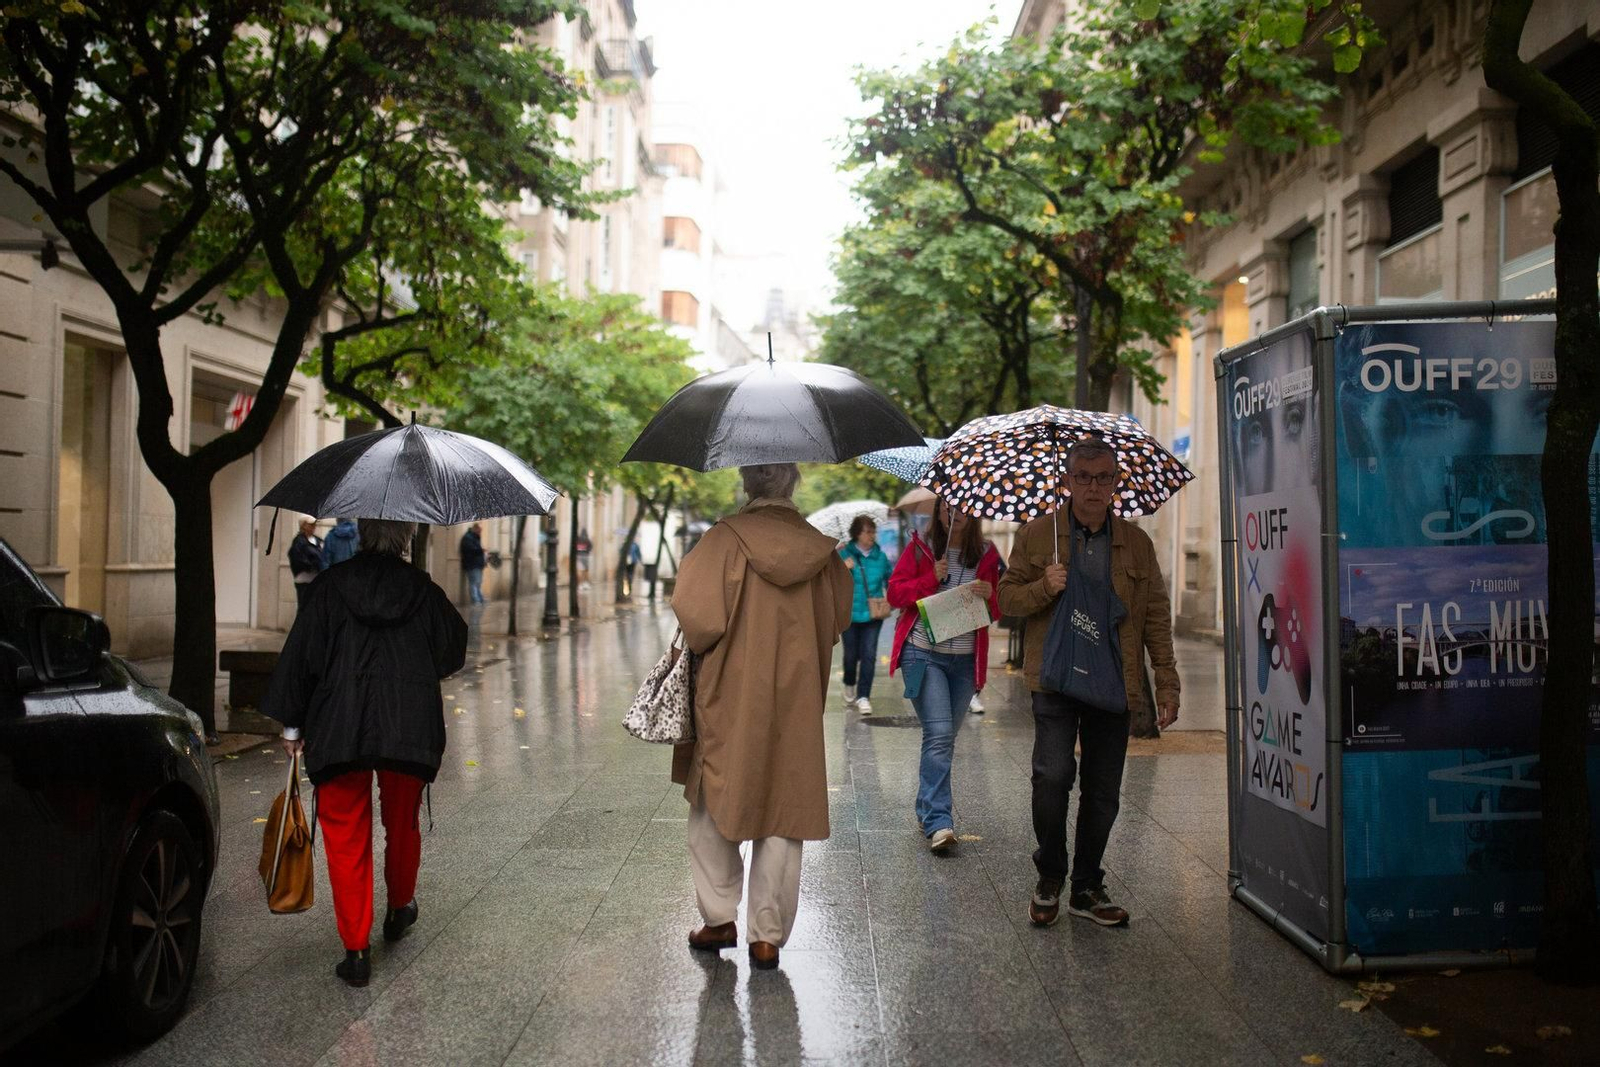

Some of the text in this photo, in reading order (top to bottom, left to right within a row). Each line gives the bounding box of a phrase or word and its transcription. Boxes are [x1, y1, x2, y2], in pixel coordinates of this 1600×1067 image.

[1360, 355, 1523, 393] OUFF29
[1233, 377, 1281, 420] OUFF29
[1245, 507, 1288, 551] OUFF
[1483, 577, 1520, 592] EDICIÓN
[1396, 601, 1463, 677] FAS
[1250, 701, 1302, 756] GAME
